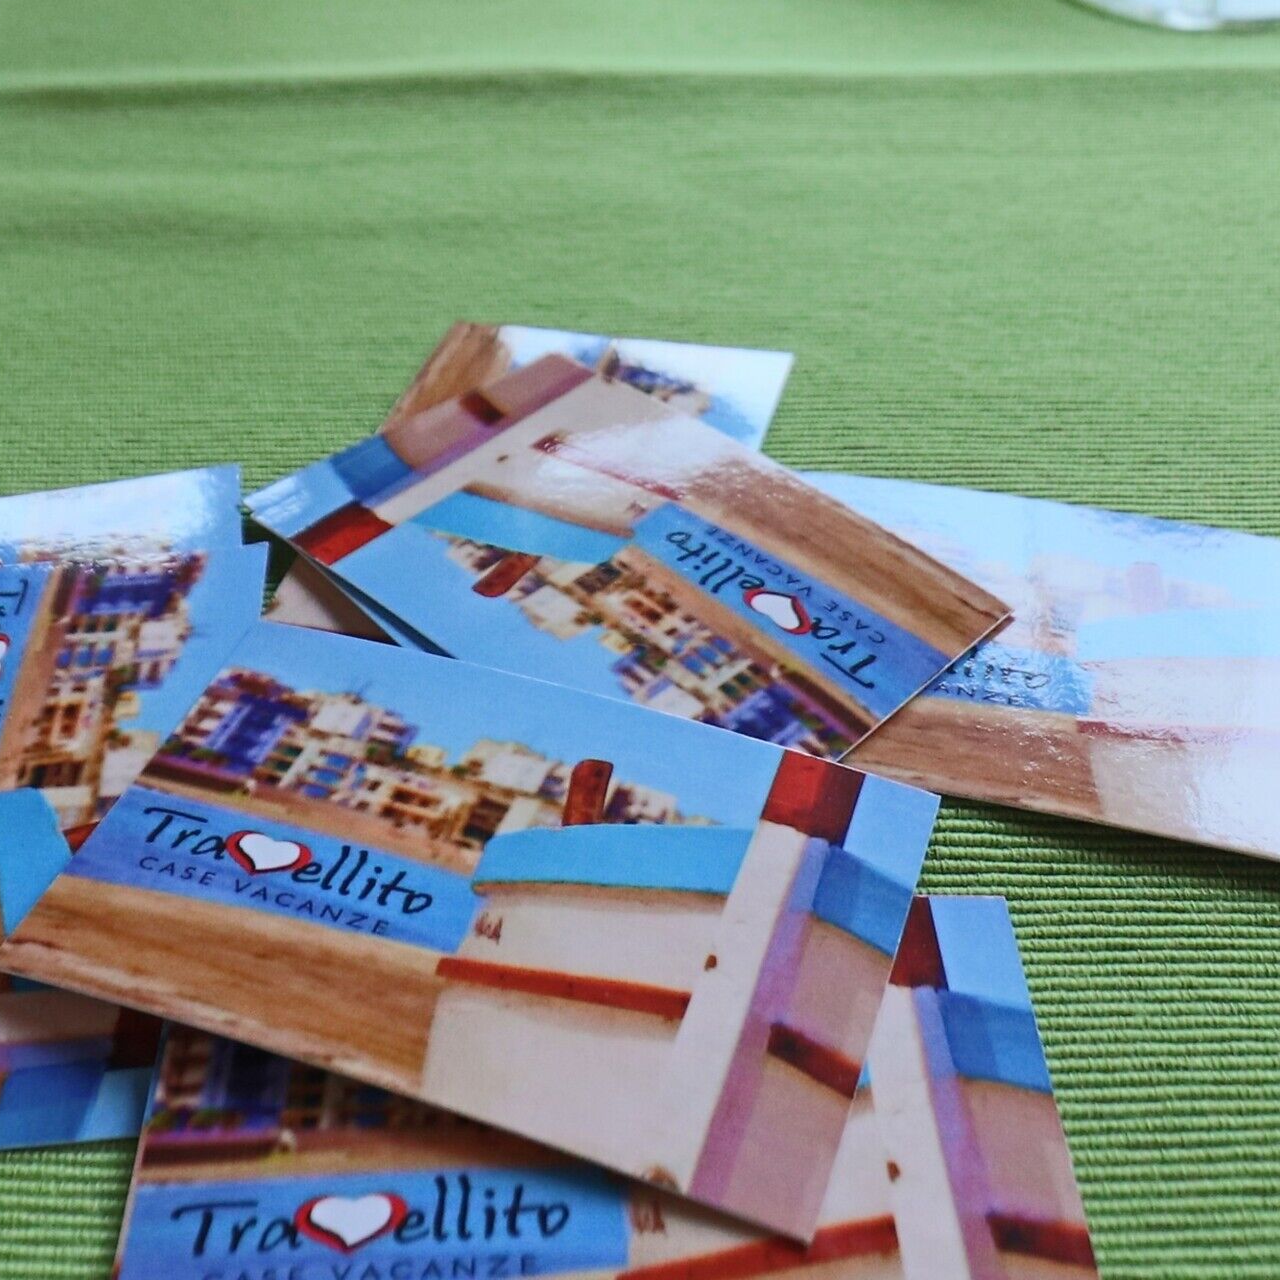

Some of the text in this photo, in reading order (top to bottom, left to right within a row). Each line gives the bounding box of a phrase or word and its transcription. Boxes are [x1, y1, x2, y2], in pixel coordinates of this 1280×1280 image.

[704, 526, 886, 645] CASE VACANZE
[138, 856, 391, 937] CASE VACANZE
[330, 1253, 538, 1280] VACANZE
